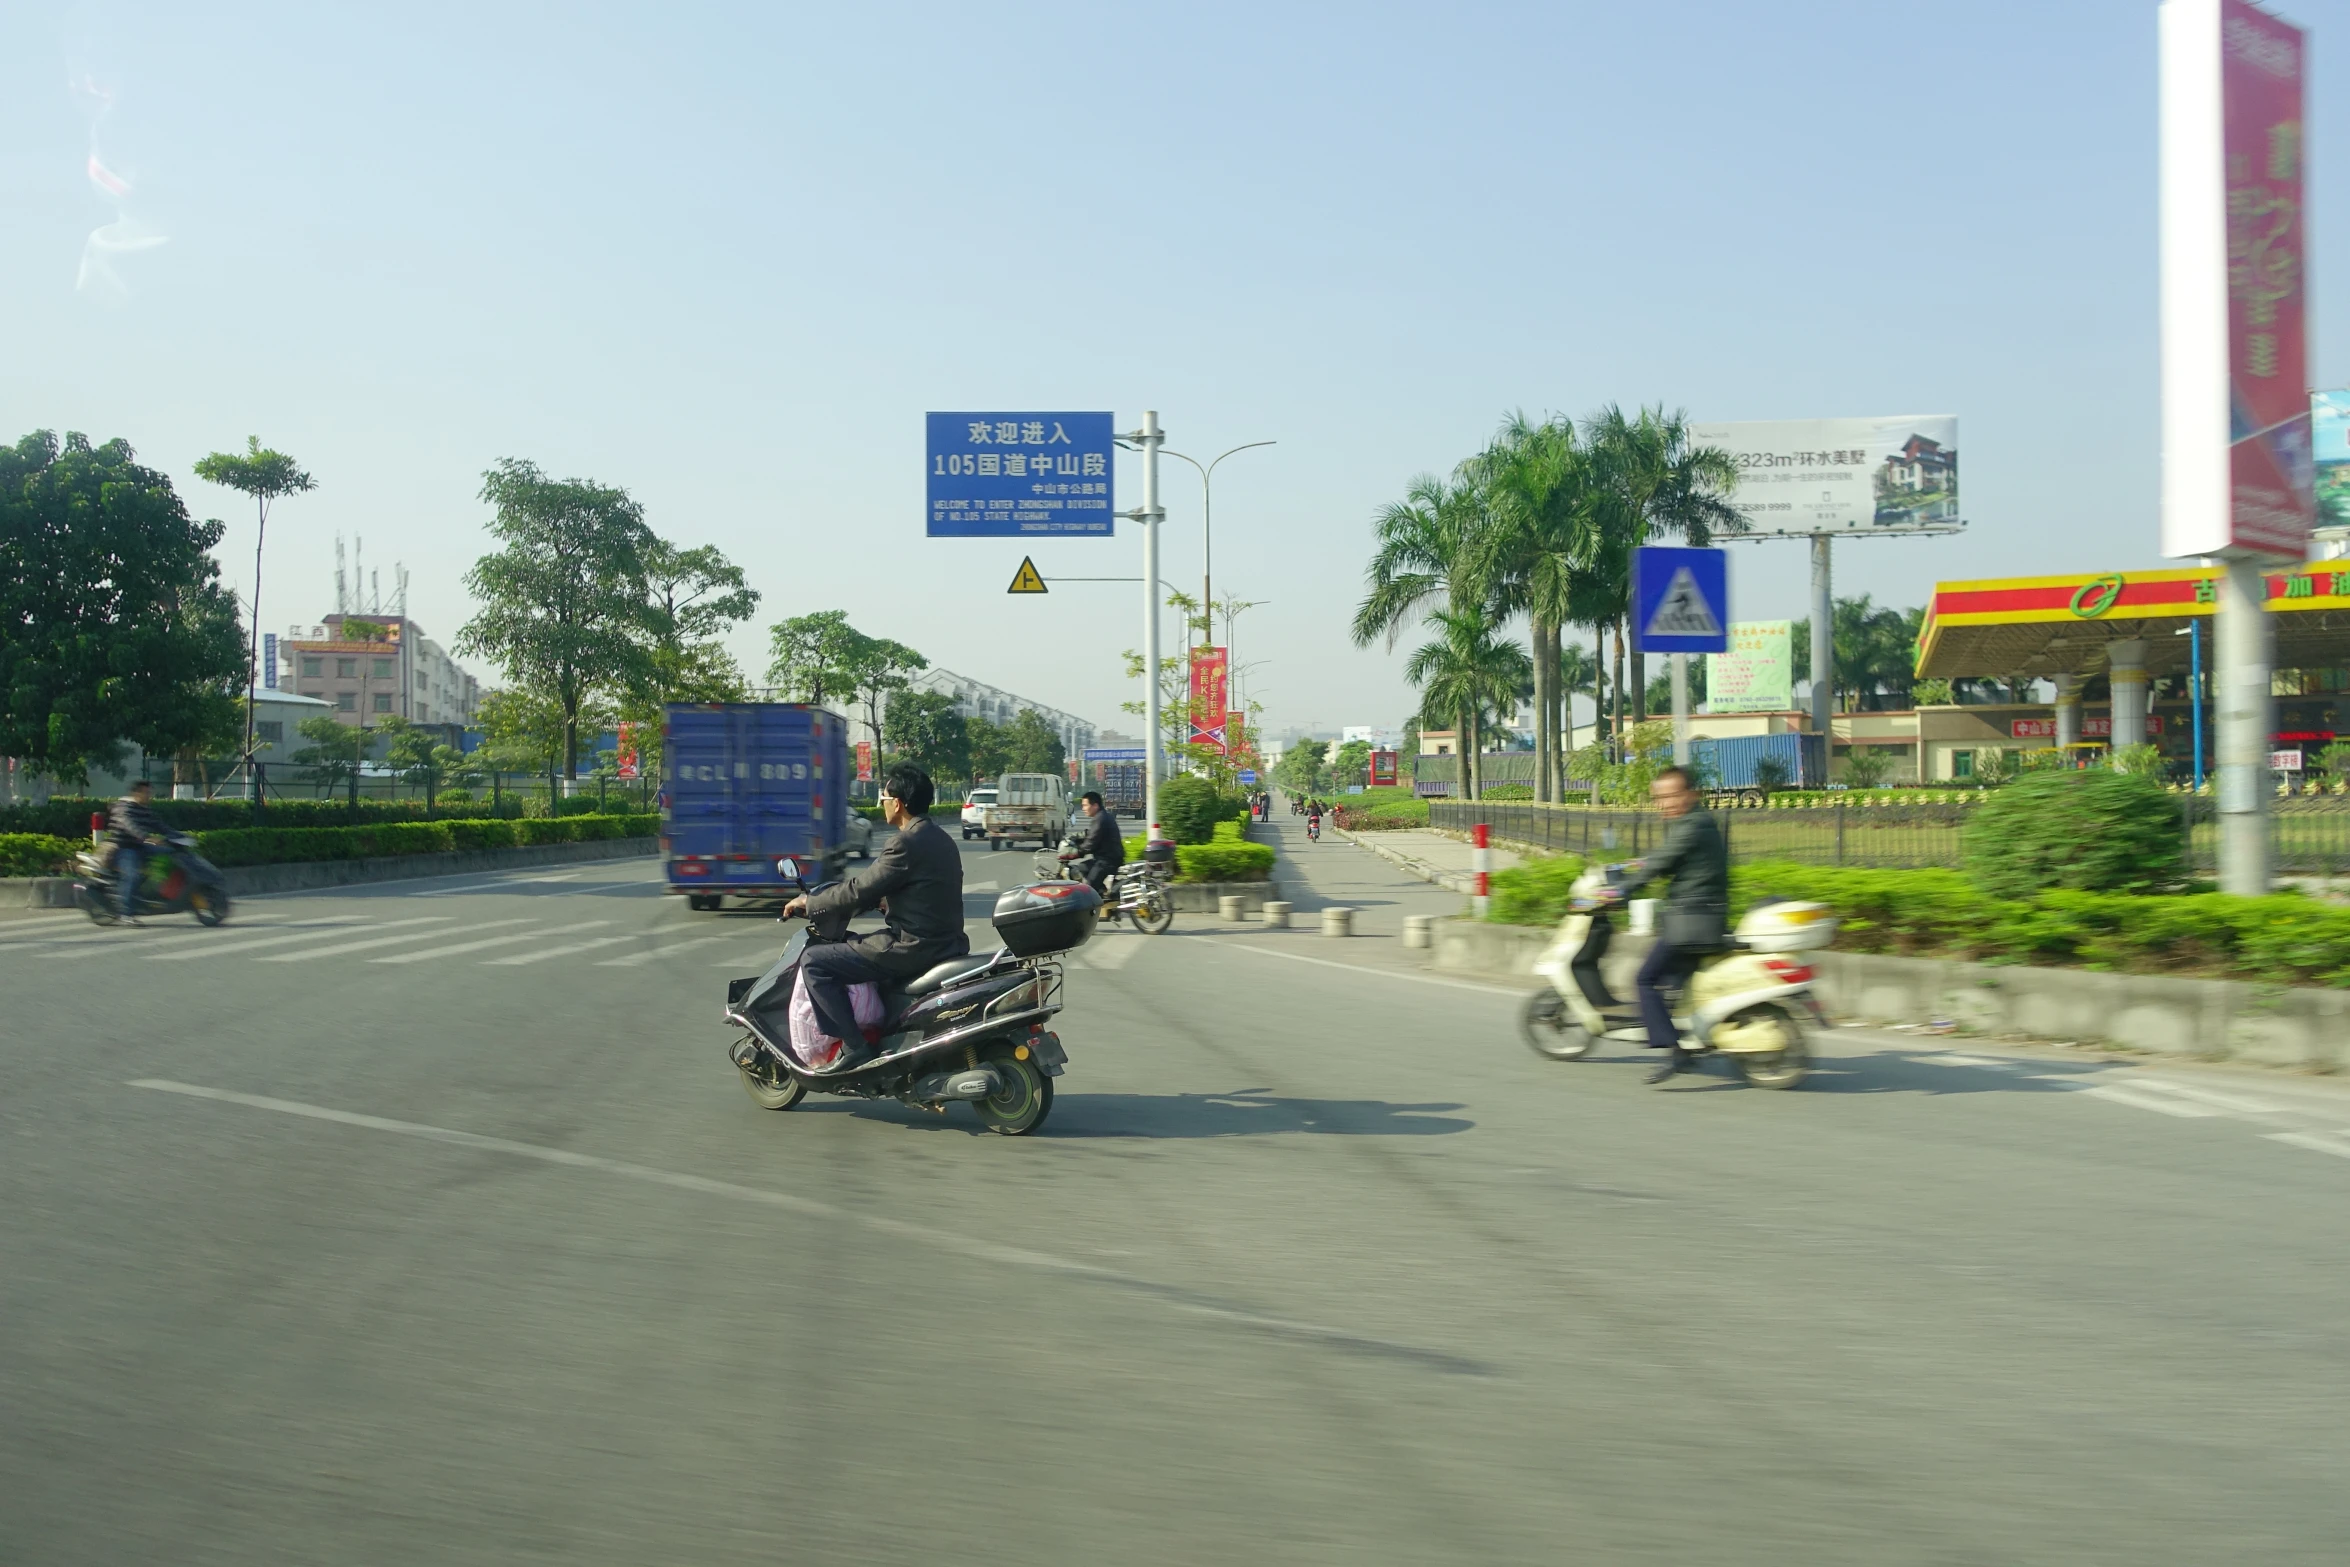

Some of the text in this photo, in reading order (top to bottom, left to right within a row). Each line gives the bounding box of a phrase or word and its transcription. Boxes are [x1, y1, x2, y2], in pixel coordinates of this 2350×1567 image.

[968, 421, 1071, 445] 欢迎进入
[934, 453, 1106, 477] 105国道中山段
[1031, 482, 1107, 495] 中山市公路局
[934, 499, 1107, 510] WELCOME TO ENTER ZHONGSHAN DIVISION
[934, 511, 945, 521] OF
[949, 511, 980, 521] NO.105
[984, 511, 1010, 521] STATE
[1050, 523, 1063, 531] CITY
[2192, 571, 2350, 604] 古加油
